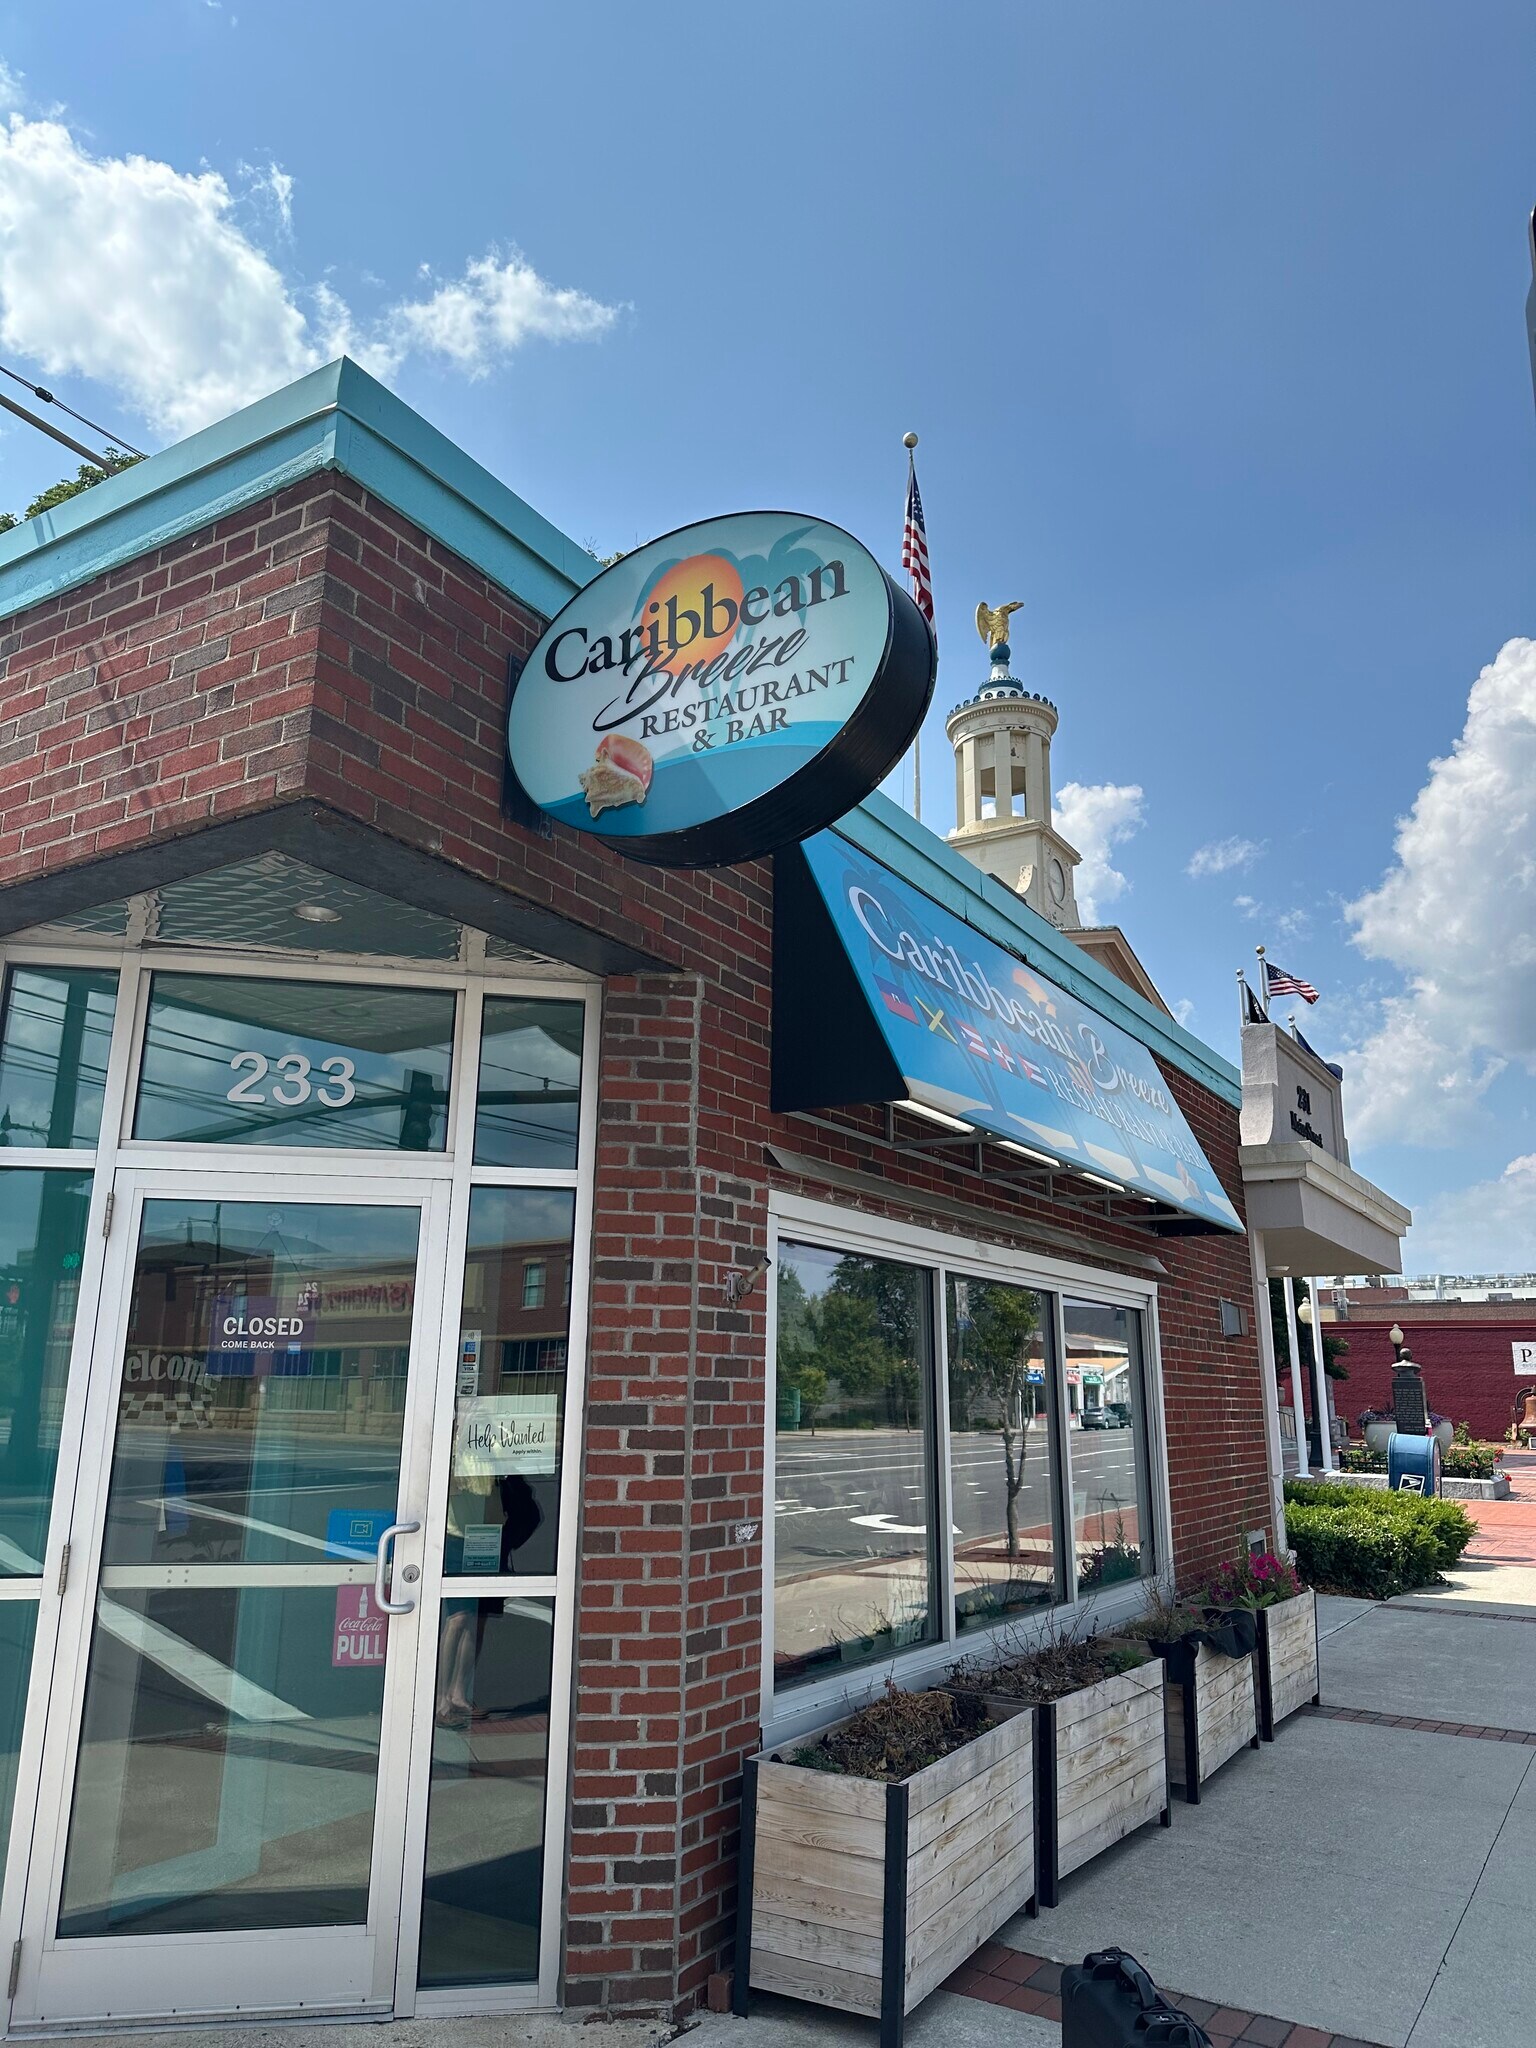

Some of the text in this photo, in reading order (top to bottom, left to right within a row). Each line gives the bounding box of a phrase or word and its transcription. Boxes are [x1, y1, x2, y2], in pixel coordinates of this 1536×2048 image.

[545, 560, 850, 682] Caribbean
[593, 627, 808, 731] Breeze
[640, 656, 855, 739] RESTAURANT
[692, 707, 791, 752] & BAR
[849, 887, 1170, 1114] Caribbean Breeze
[227, 1051, 356, 1107] 233
[1043, 1065, 1208, 1171] RESTAURANT & BAR
[221, 1341, 275, 1349] COME BACK
[223, 1317, 304, 1336] CLOSED
[124, 1350, 222, 1391] elcome
[467, 1420, 547, 1452] Help Wanted
[339, 1616, 384, 1632] Coca-Cola
[336, 1634, 384, 1661] PULL
